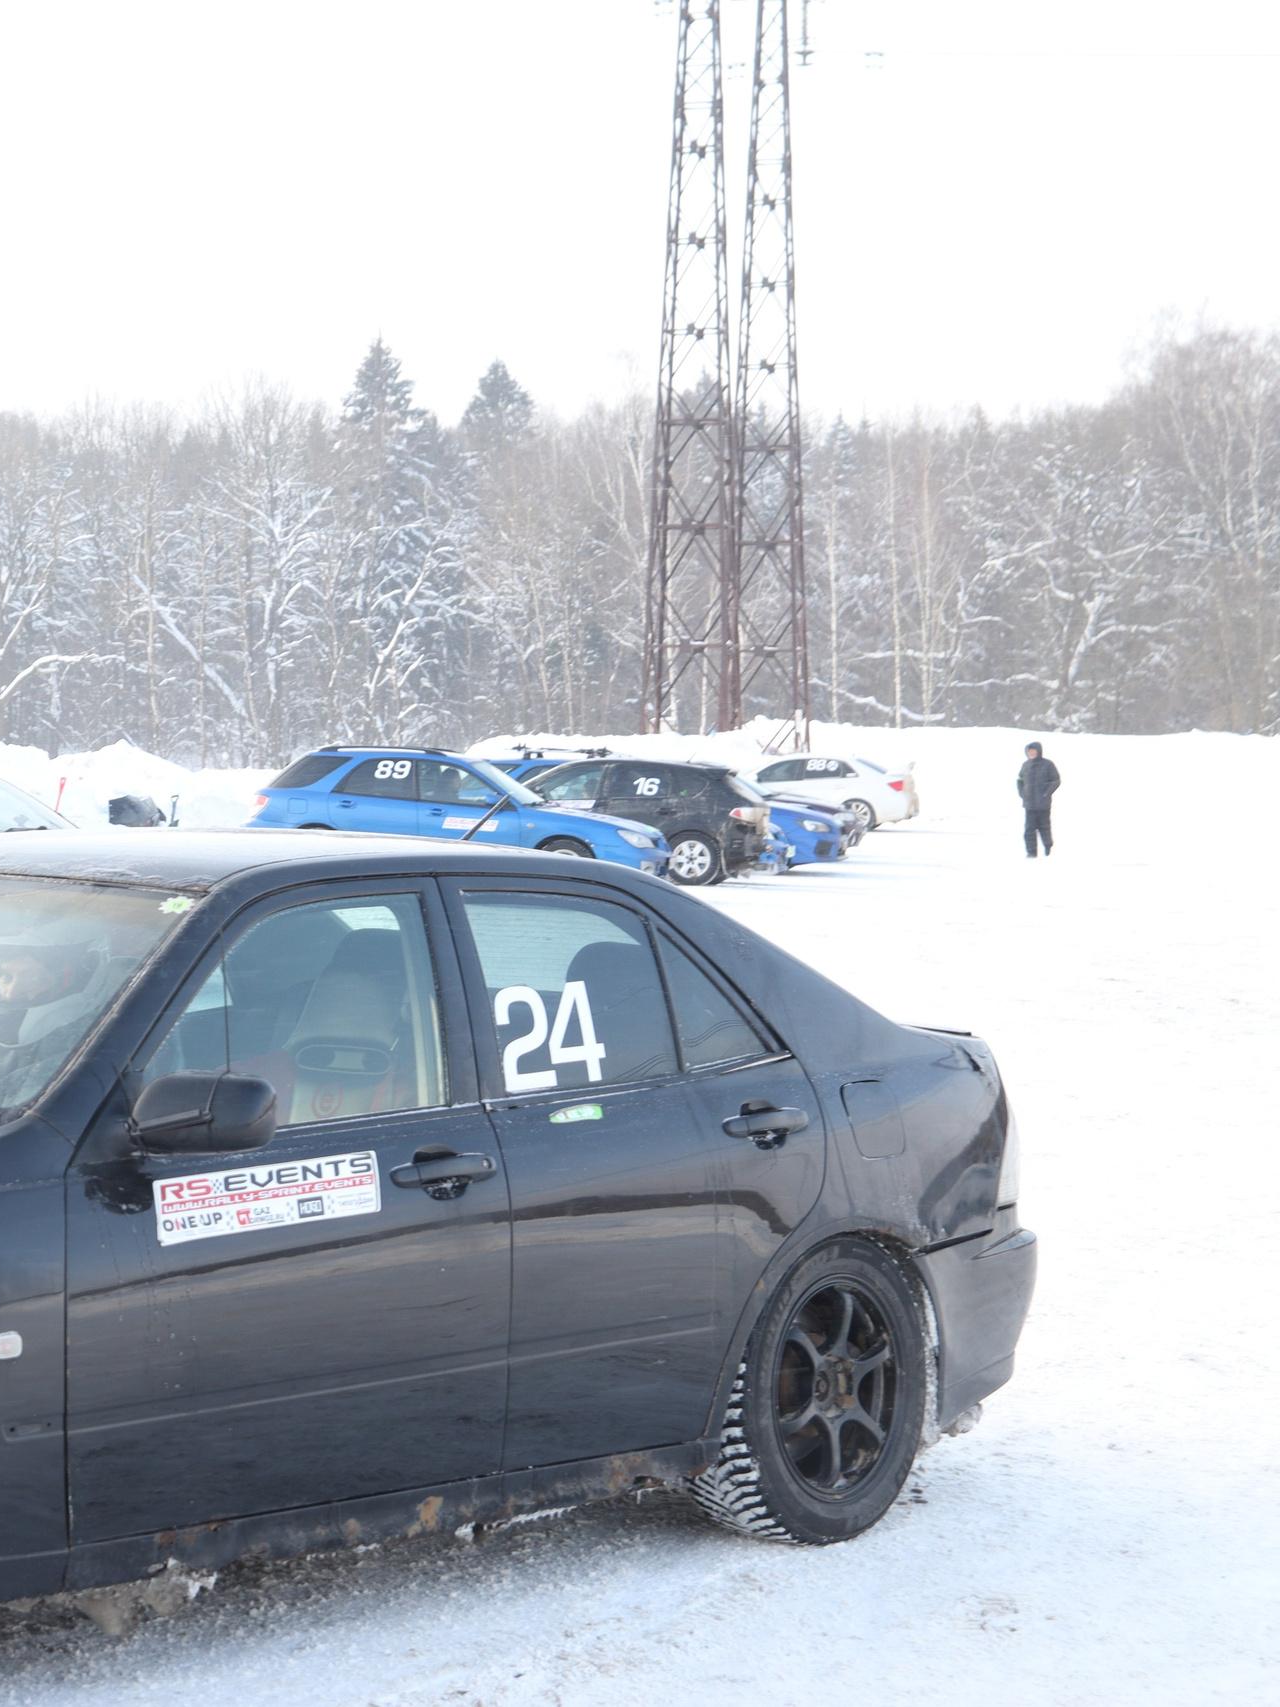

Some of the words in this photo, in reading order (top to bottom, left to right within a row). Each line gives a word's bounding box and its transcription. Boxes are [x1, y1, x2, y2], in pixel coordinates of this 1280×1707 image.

[374, 760, 412, 779] 89
[806, 759, 827, 771] 88
[633, 777, 661, 796] 16
[493, 980, 607, 1094] 24
[160, 1178, 212, 1201] RS
[223, 1156, 372, 1192] EVENTS
[253, 1206, 271, 1216] GAZ
[163, 1214, 198, 1232] ONE
[200, 1212, 223, 1226] UP
